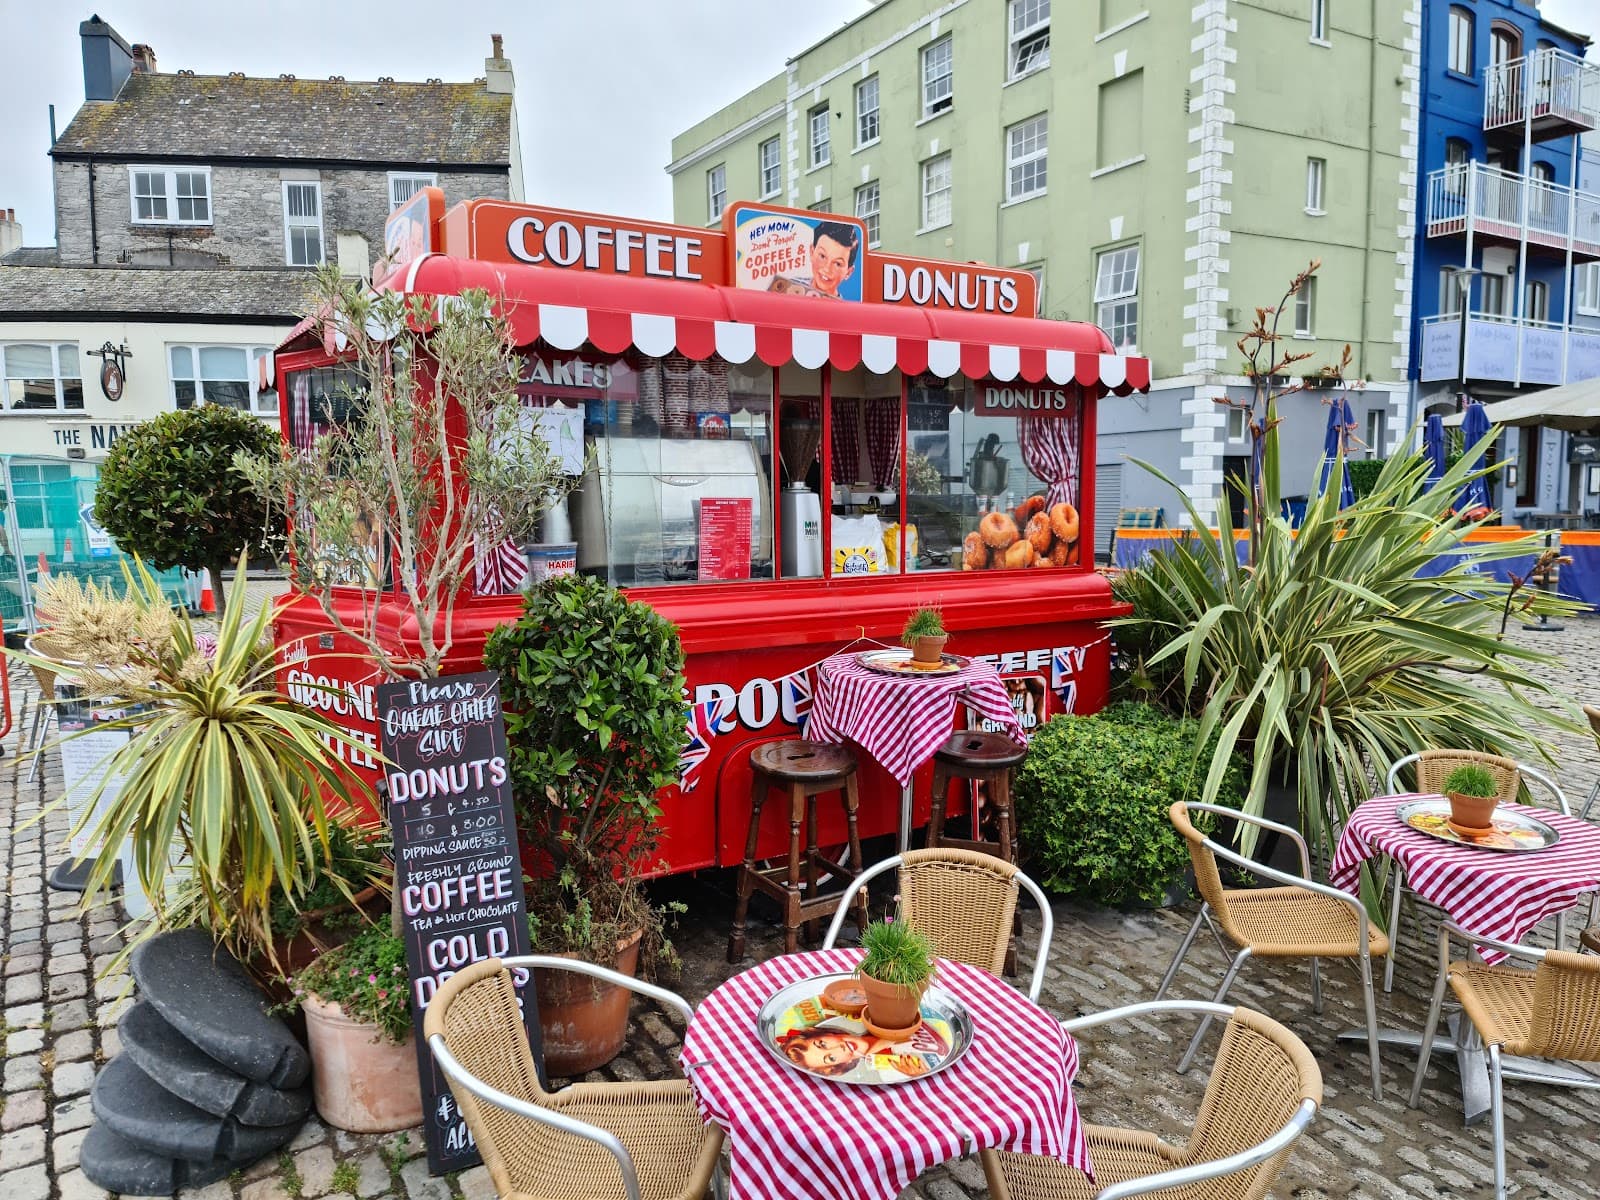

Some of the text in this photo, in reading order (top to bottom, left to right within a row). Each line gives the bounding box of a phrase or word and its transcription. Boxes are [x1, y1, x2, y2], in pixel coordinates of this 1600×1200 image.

[750, 221, 796, 240] HEY MOM!
[506, 216, 703, 281] COFFEE
[745, 244, 806, 270] COFFEE &
[752, 255, 806, 280] DONUTS!
[882, 262, 1019, 314] DONUTS
[985, 387, 1067, 410] DONUTS
[53, 429, 81, 445] THE
[409, 681, 477, 706] Please
[386, 695, 497, 737] QUEUE OTHER
[419, 727, 465, 757] SIDE
[390, 756, 508, 804] DONUTS
[421, 802, 433, 817] 5
[402, 844, 448, 861] DIPPING
[448, 836, 482, 854] SAUCE
[407, 855, 514, 885] FRESHLY GROUND
[402, 868, 513, 917] COFFEE
[409, 917, 433, 932] TEA
[445, 911, 467, 924] HOT
[467, 901, 520, 922] CHOCOLATE
[426, 926, 510, 971] COLD
